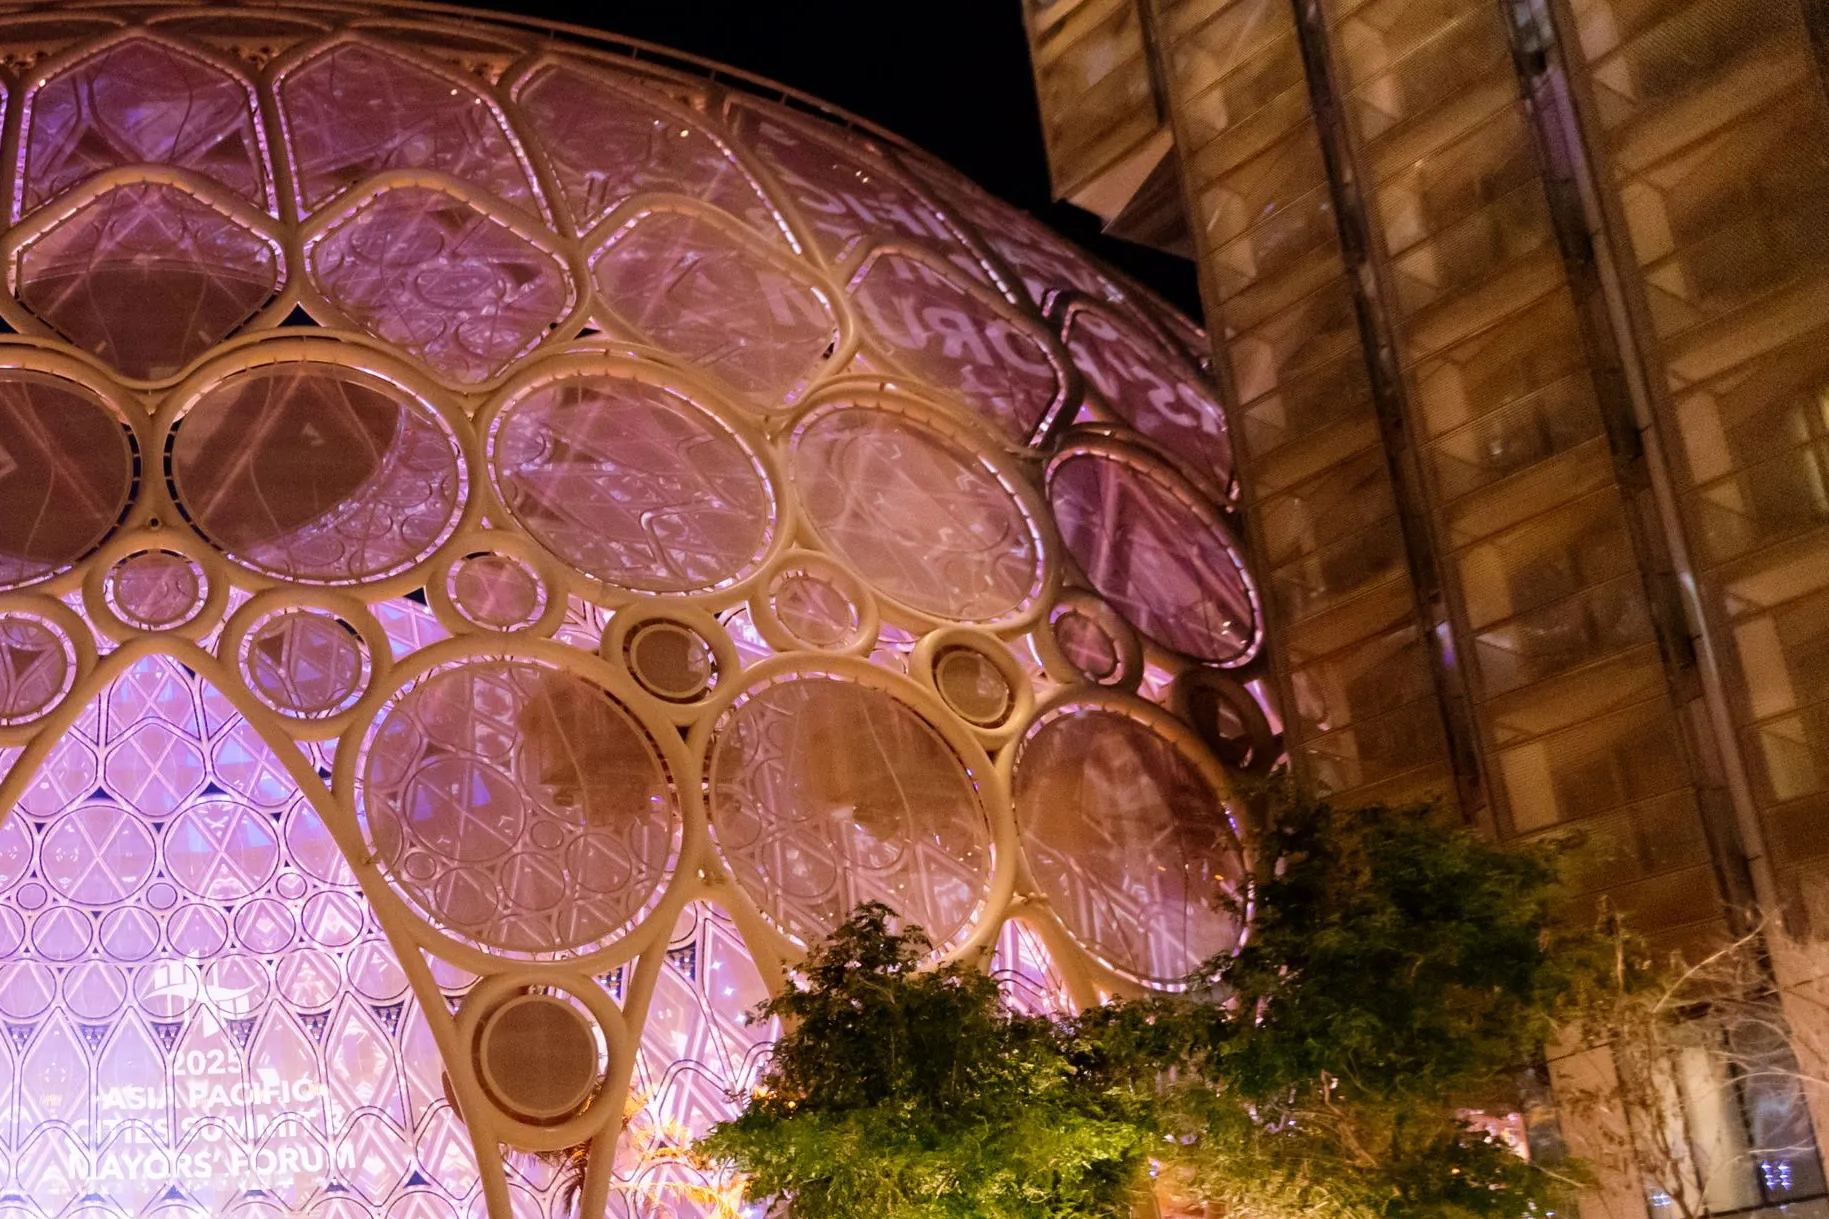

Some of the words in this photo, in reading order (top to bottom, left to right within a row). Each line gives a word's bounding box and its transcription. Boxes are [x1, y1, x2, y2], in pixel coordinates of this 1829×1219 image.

[168, 1048, 244, 1076] 2025
[102, 1084, 181, 1110] ASIA
[189, 1079, 318, 1109] PACIFIC
[72, 1118, 171, 1145] CITIES
[181, 1108, 318, 1142] SUMMIT
[68, 1150, 221, 1180] MAYORS'
[230, 1141, 356, 1177] FORUM
